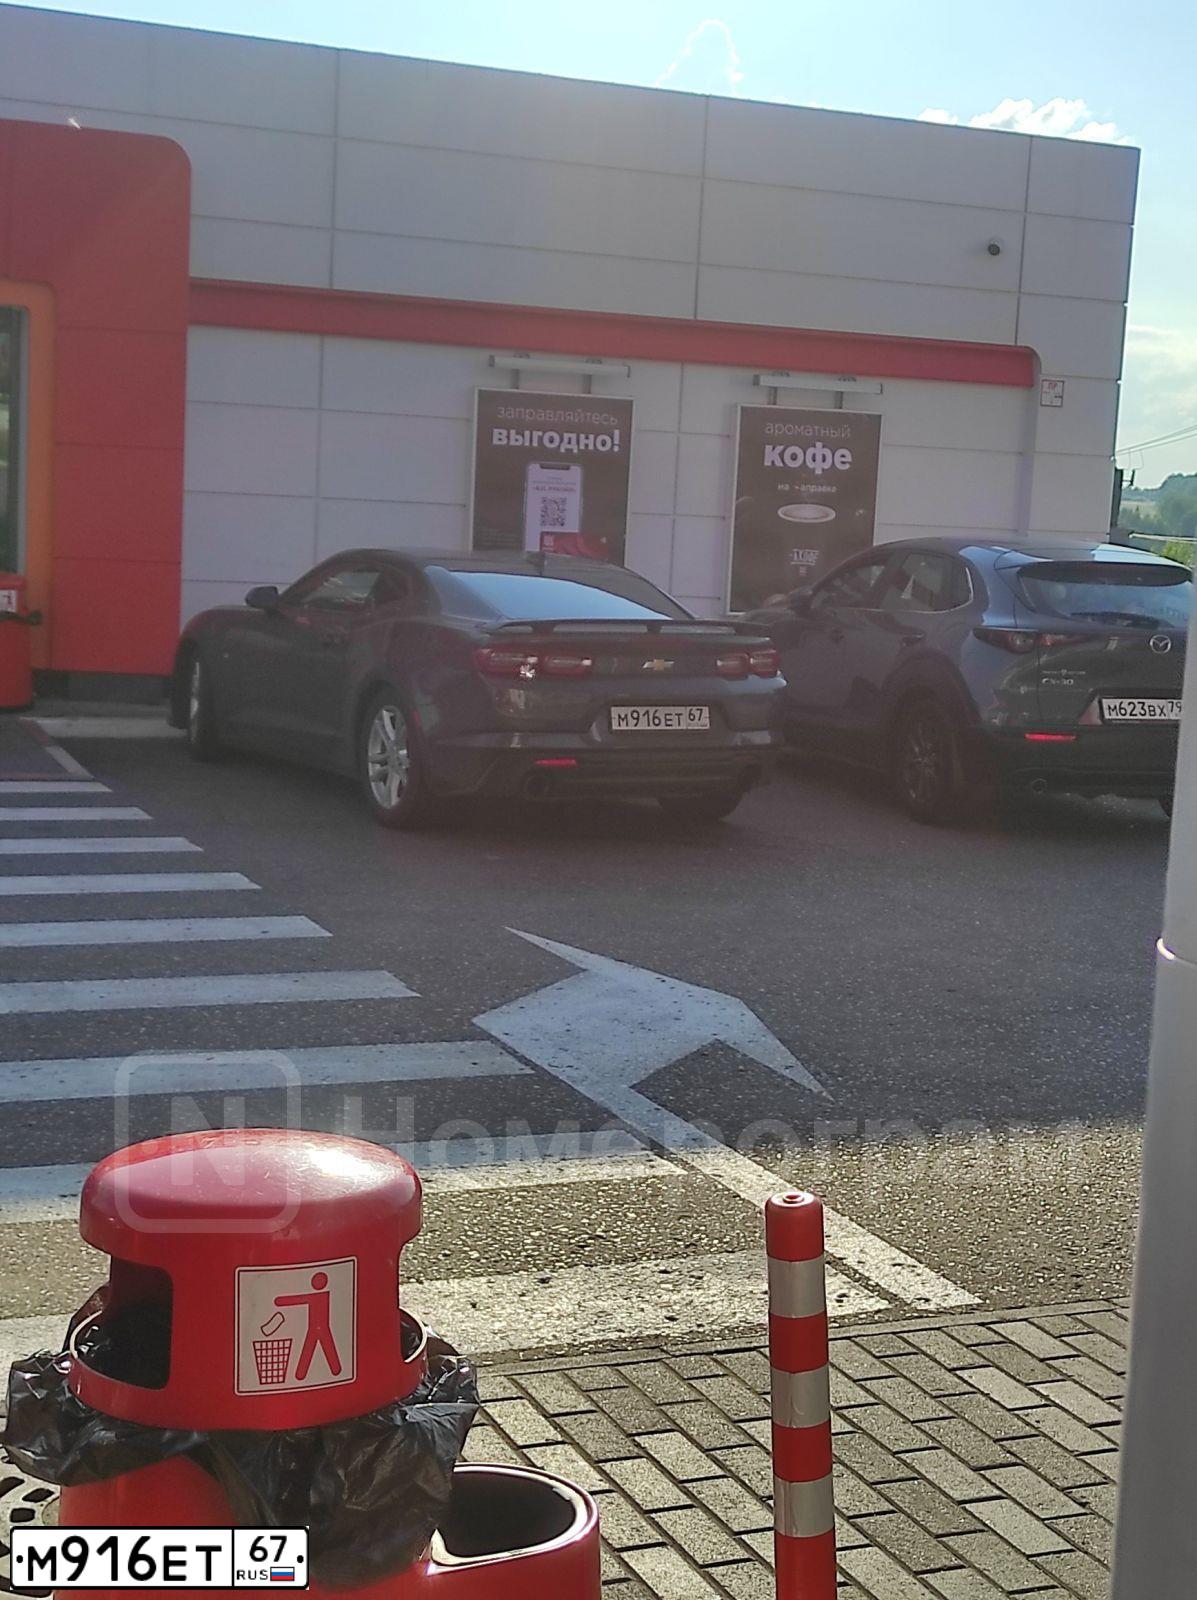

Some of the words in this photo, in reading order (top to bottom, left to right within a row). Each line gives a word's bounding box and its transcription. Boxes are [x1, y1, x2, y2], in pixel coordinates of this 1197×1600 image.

[497, 406, 619, 426] заправляйтесь
[765, 422, 851, 438] ароматный
[492, 428, 620, 453] выгодно!
[764, 442, 852, 475] кофе
[688, 708, 703, 722] 67
[1167, 701, 1182, 713] 79
